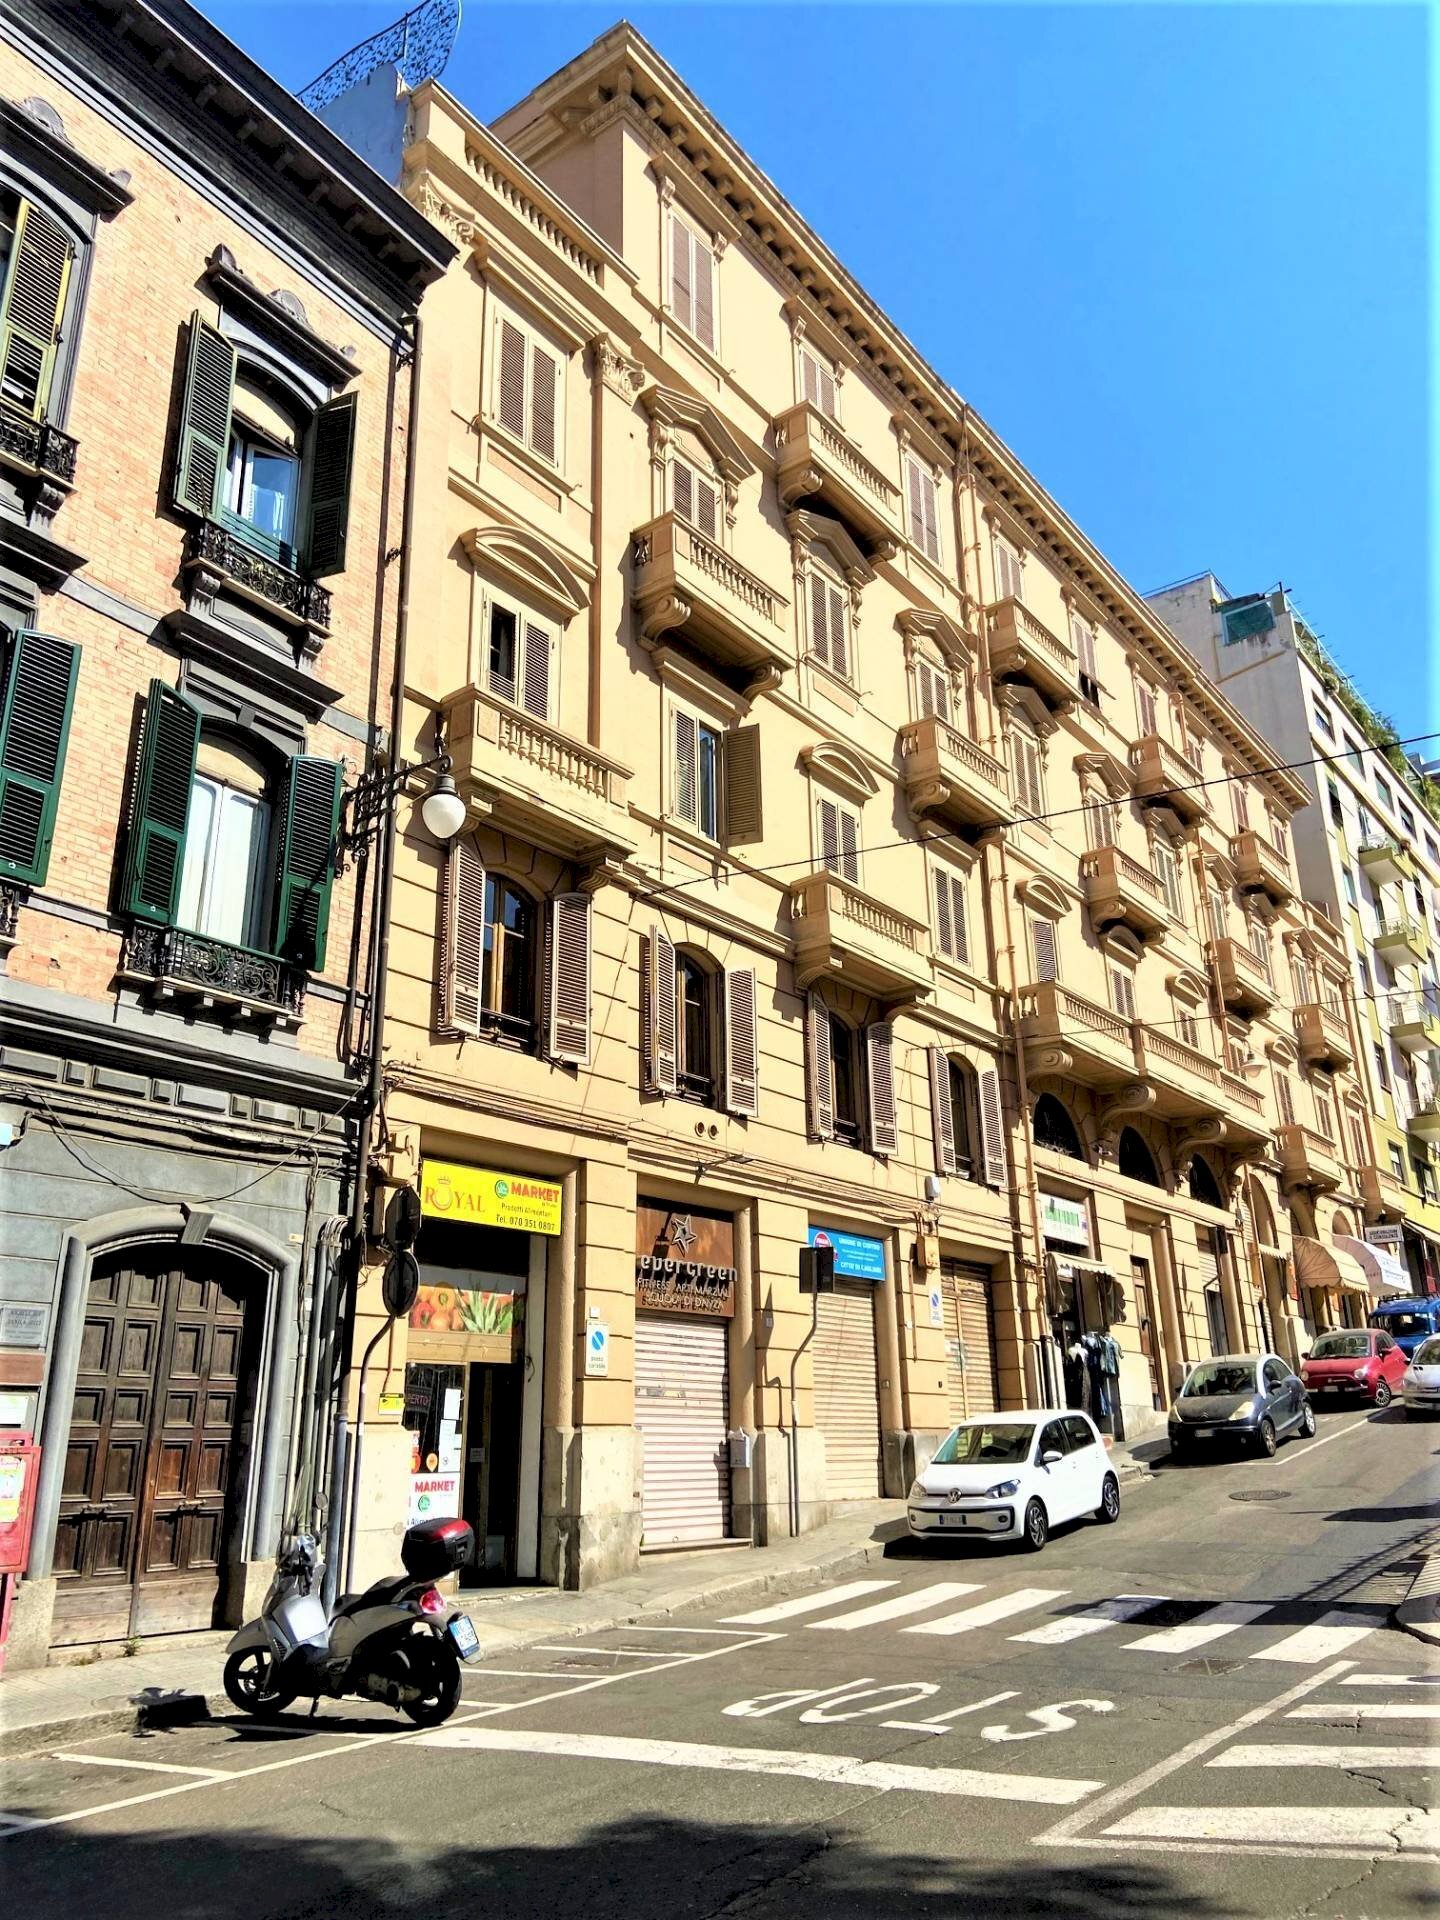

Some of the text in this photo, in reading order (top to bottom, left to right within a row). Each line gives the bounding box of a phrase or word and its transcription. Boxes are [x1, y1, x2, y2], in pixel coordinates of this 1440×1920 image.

[424, 1185, 486, 1213] ROYAL
[511, 1181, 560, 1203] MARKET
[501, 1202, 524, 1214] Prodotti
[509, 1216, 523, 1226] 070
[524, 1218, 537, 1229] 351
[640, 1254, 738, 1282] evergreen
[636, 1277, 671, 1291] FITNESS
[414, 1480, 456, 1493] MARKET
[721, 1677, 1115, 1742] STOP
